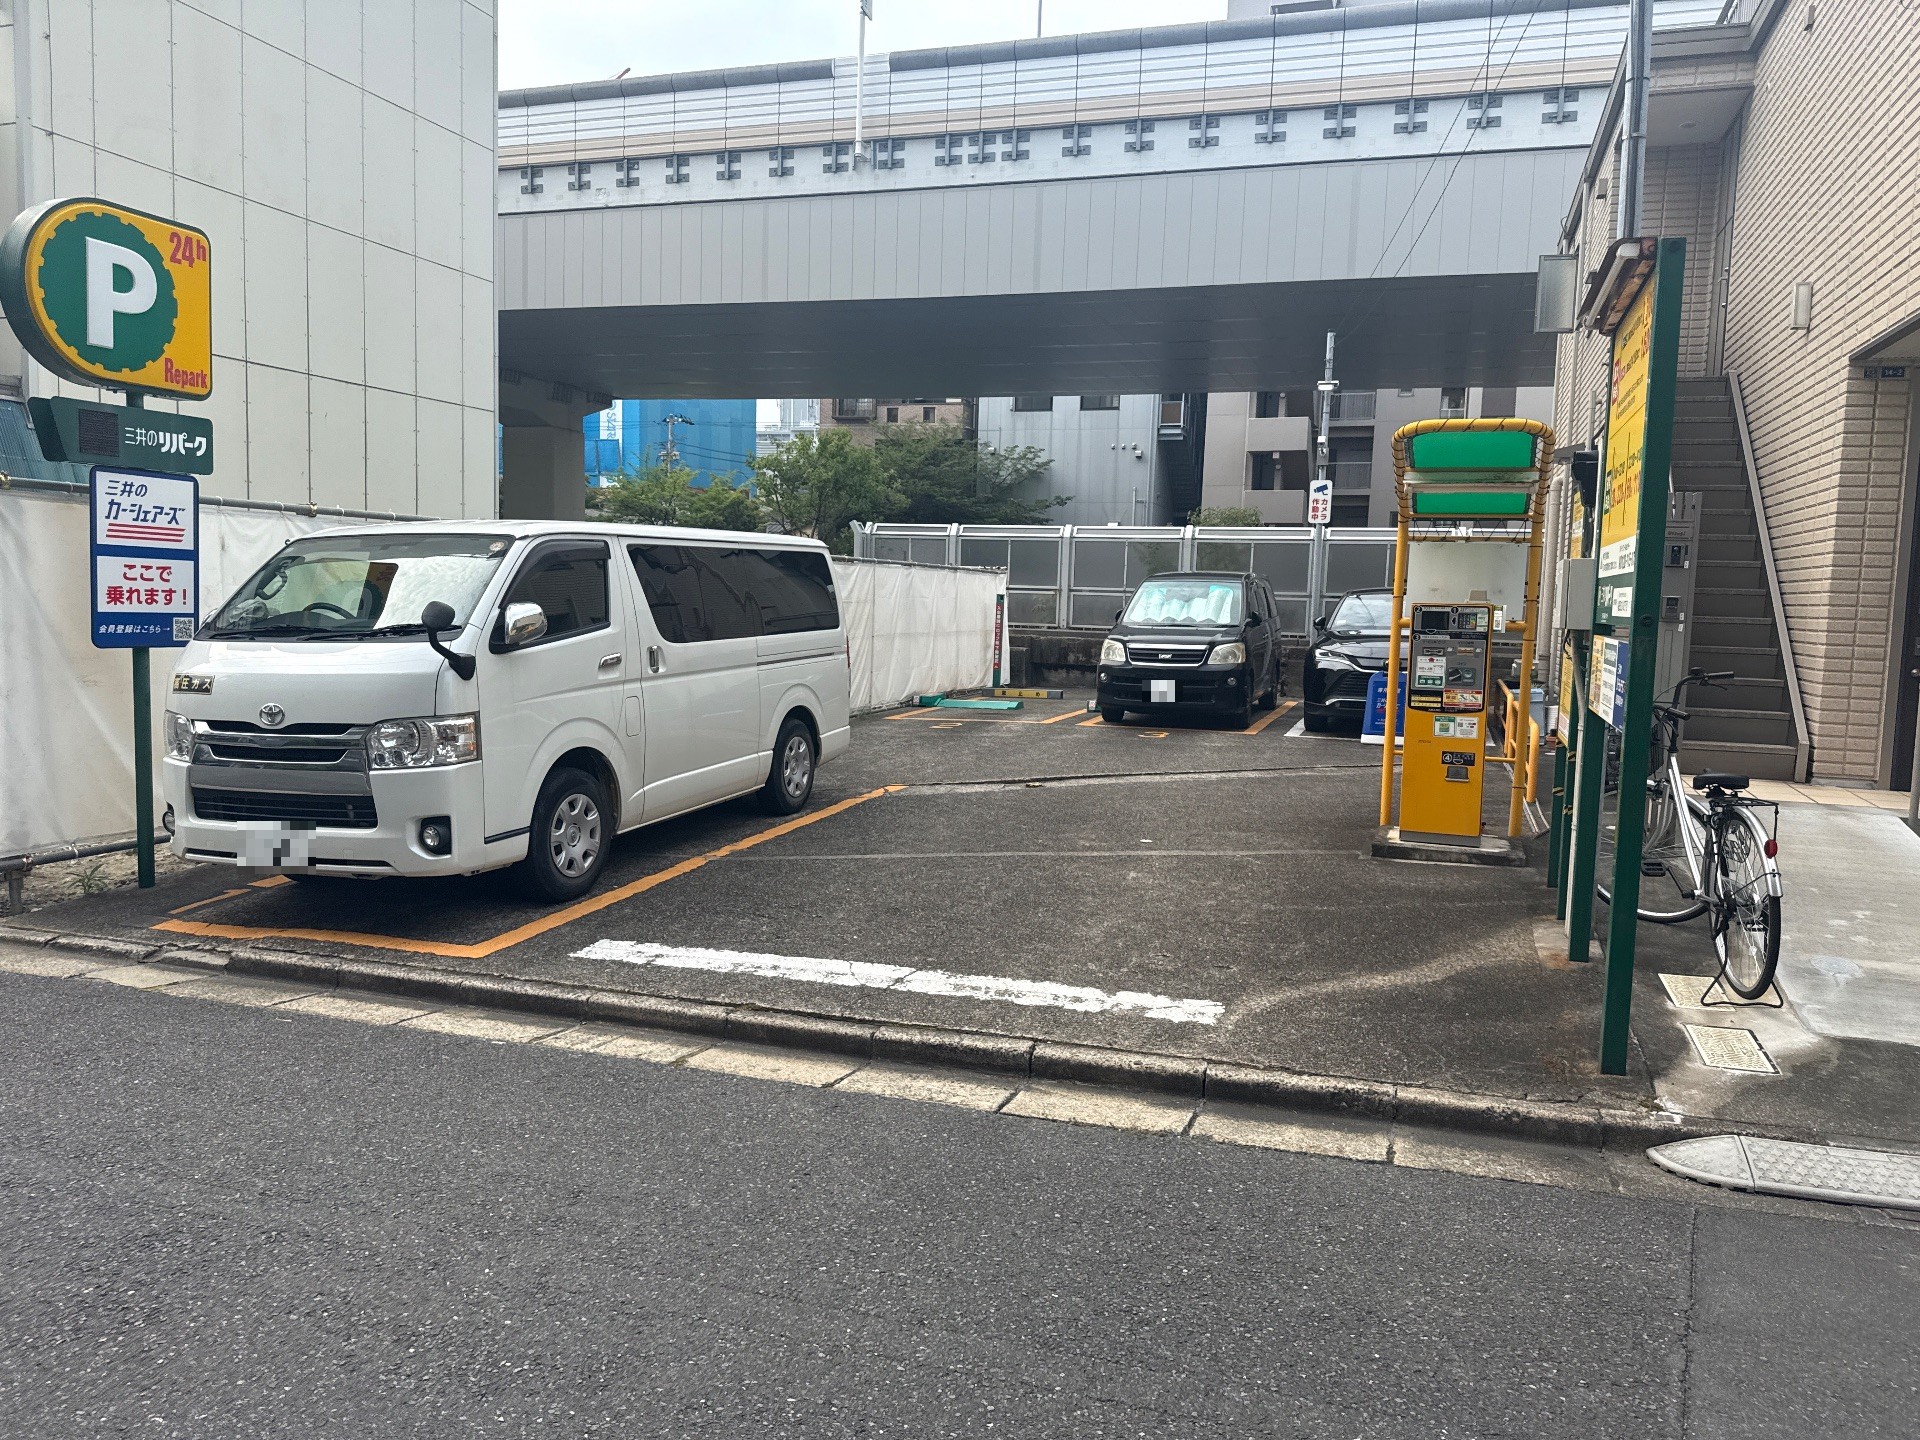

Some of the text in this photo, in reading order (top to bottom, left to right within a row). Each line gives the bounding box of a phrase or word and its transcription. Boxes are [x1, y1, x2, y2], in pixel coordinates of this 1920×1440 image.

[169, 231, 207, 268] 24h
[85, 236, 158, 350] P
[164, 357, 208, 389] Repark
[124, 427, 207, 457] 三井のリパーク
[104, 479, 148, 498] 三井の
[104, 498, 186, 526] カーシェアーズ
[1311, 498, 1320, 521] 作動中
[1320, 498, 1328, 521] カメラ
[122, 563, 173, 583] ここで
[105, 585, 187, 606] 乗れます！
[98, 624, 161, 634] 会員登録はこちら
